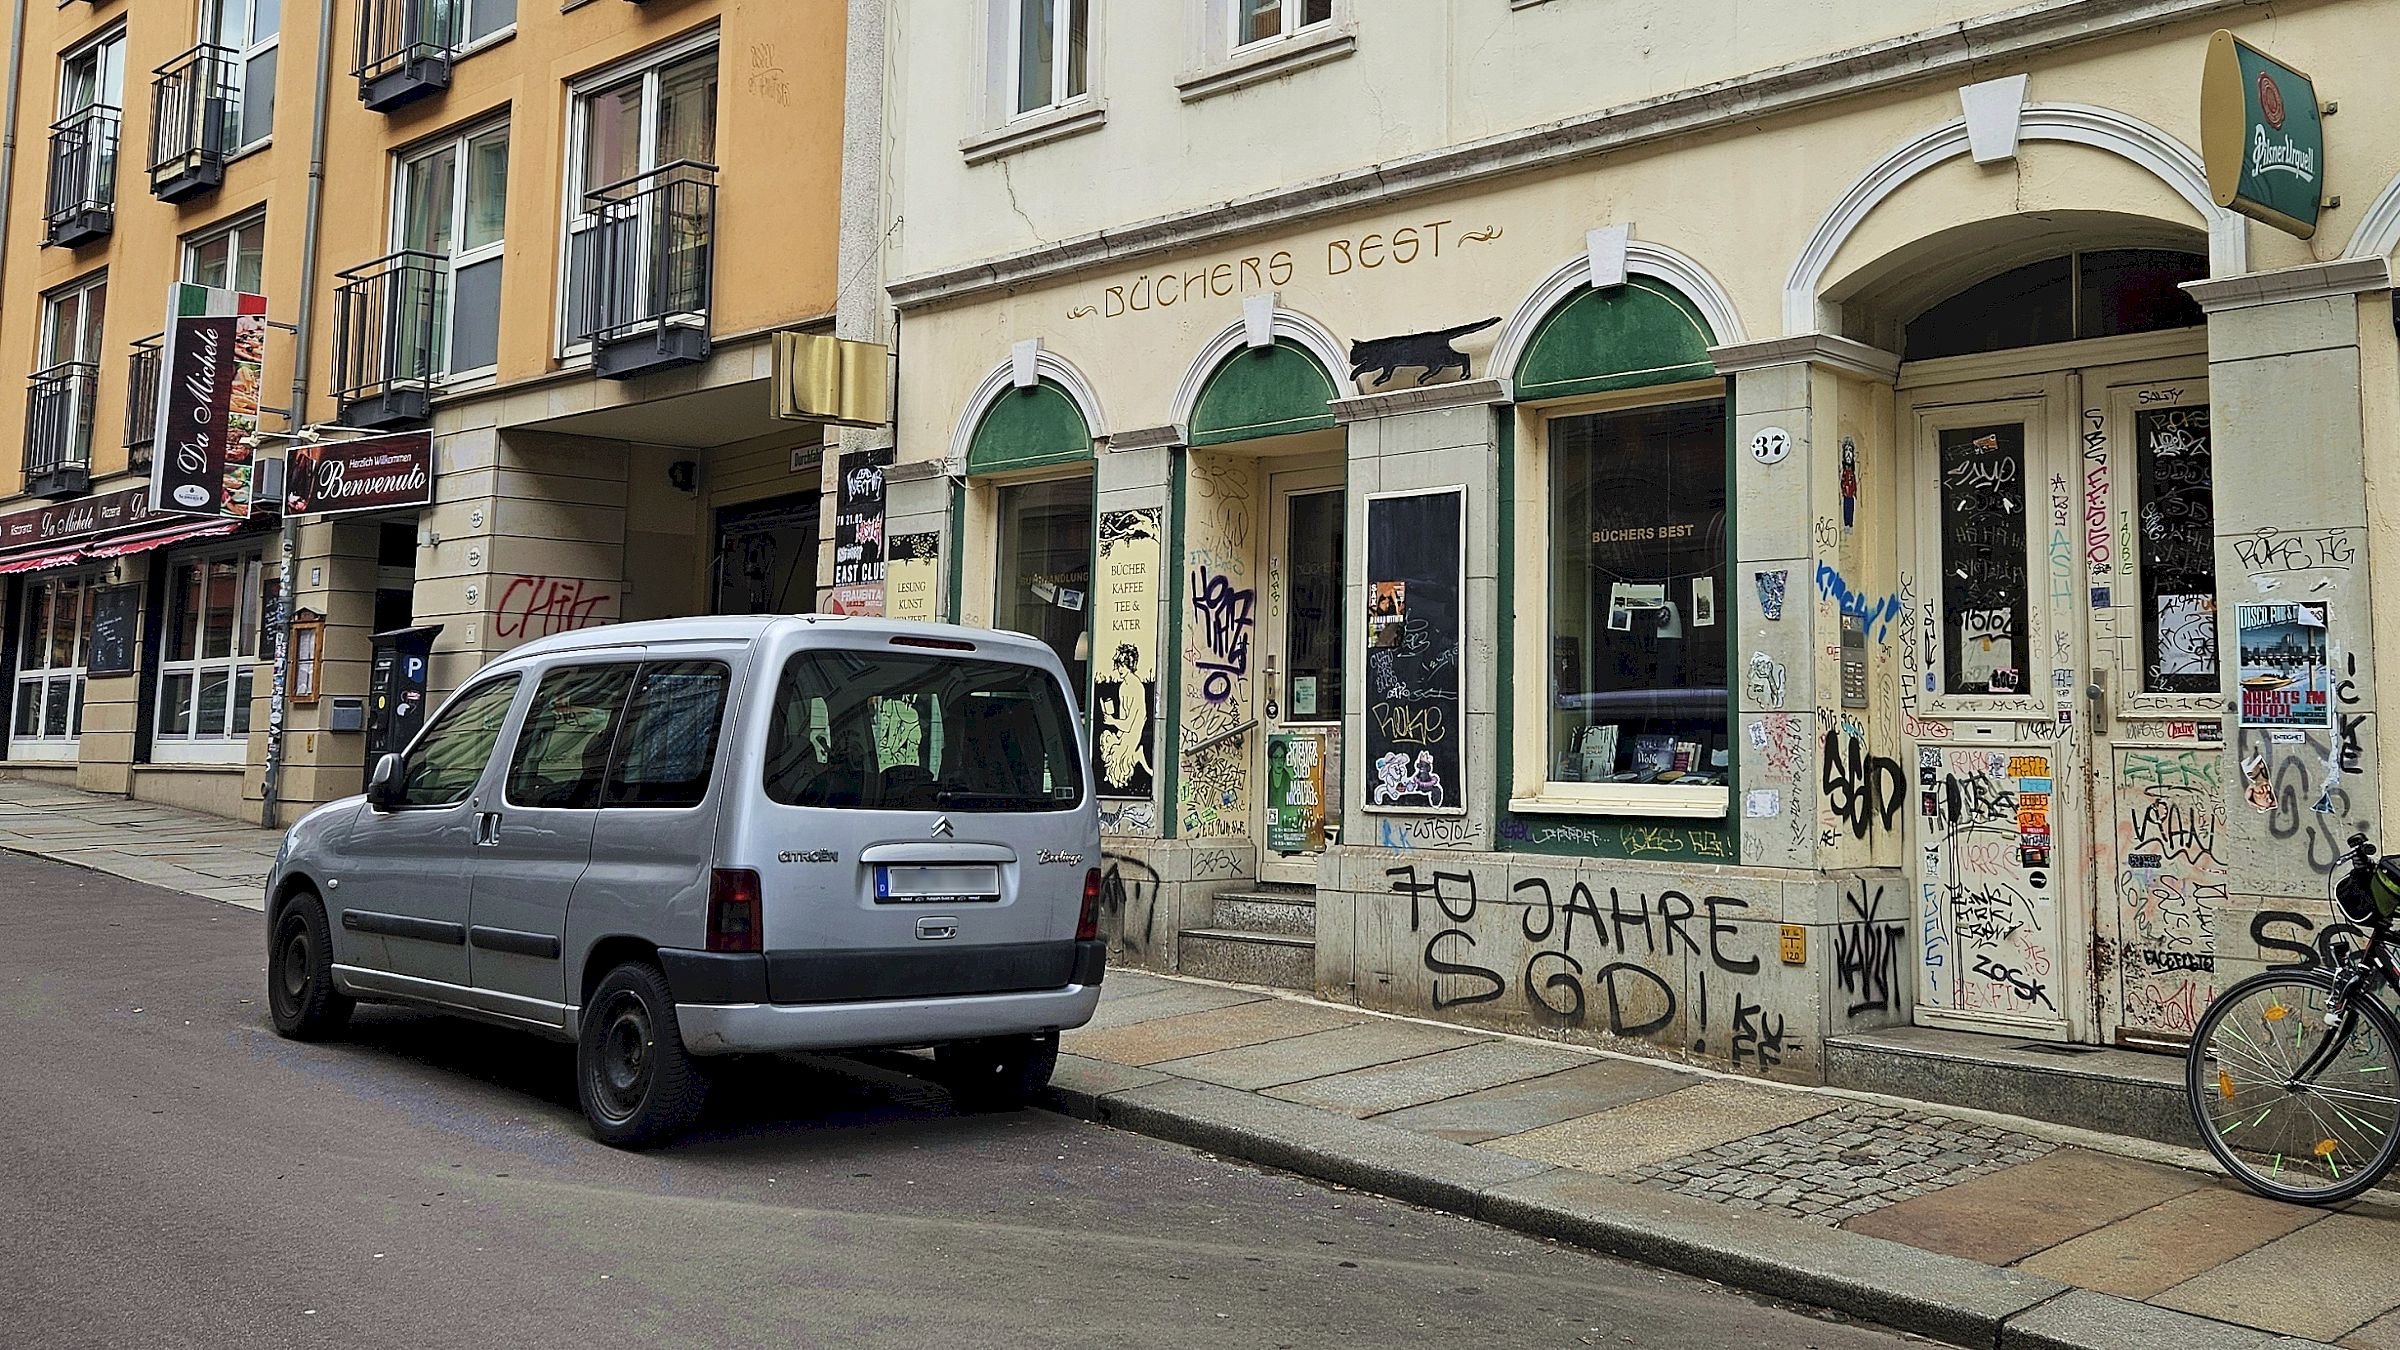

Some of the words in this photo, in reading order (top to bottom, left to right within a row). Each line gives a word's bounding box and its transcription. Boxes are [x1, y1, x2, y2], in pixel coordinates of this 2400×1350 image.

[2252, 123, 2286, 177] Pilsner
[2285, 134, 2314, 179] Urquell
[1105, 251, 1294, 319] BÜCHERS
[1327, 220, 1453, 276] BEST
[185, 328, 219, 425] Michele
[177, 432, 208, 474] Da
[1754, 434, 1785, 458] 37
[349, 456, 373, 469] Herzlich
[374, 453, 412, 466] Willkommen
[317, 460, 426, 500] Benvenuto
[58, 506, 94, 533] Michele
[1592, 525, 1655, 544] BÜCHERS
[1658, 523, 1695, 540] BEST
[836, 564, 858, 584] EAST
[861, 562, 885, 581] CLUB
[1111, 561, 1147, 577] BÜCHER
[841, 589, 884, 602] FRAUENTA
[897, 582, 926, 593] LESUNG
[1112, 581, 1144, 595] KAFFEE
[898, 599, 923, 610] KUNST
[1115, 600, 1131, 613] TEE
[1132, 600, 1141, 612] &
[1112, 618, 1141, 631] KATER
[407, 657, 423, 678] P
[778, 848, 839, 863] CITROËN
[1514, 878, 1760, 975] JAHRE
